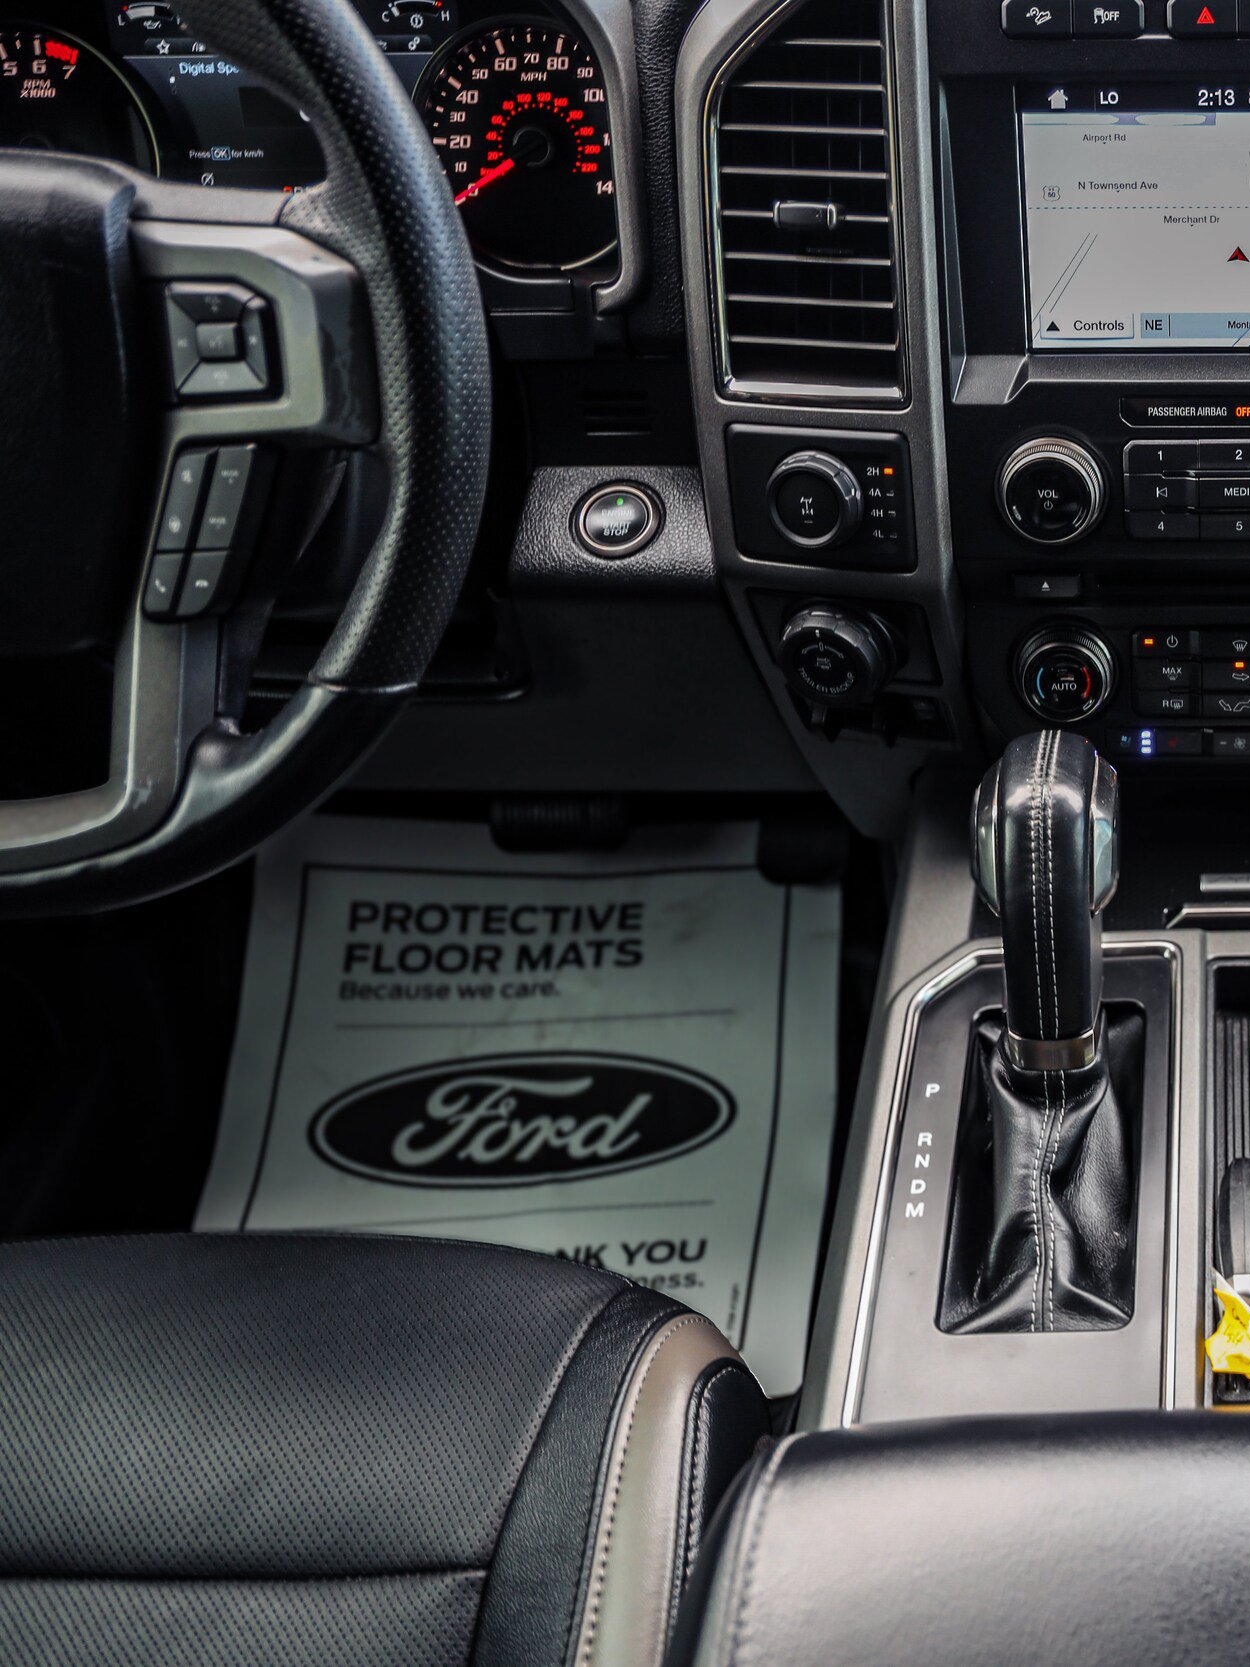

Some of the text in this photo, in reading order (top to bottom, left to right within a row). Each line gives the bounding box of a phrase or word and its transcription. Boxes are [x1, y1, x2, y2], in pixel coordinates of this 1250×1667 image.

[381, 11, 390, 22] C
[441, 10, 450, 22] H
[1104, 11, 1120, 21] OFF
[494, 57, 518, 72] 60
[523, 53, 540, 65] 70
[546, 56, 570, 71] 80
[3, 61, 18, 77] 5
[32, 59, 47, 75] 6
[62, 64, 77, 80] 7
[179, 61, 214, 76] Digital
[577, 67, 594, 79] 90
[472, 68, 489, 80] 50
[520, 72, 548, 82] MPH
[23, 79, 51, 90] RPM
[456, 90, 479, 104] 40
[536, 91, 552, 103] 120
[1100, 91, 1119, 105] LO
[1198, 89, 1235, 106] 2:13
[449, 111, 466, 123] 30
[449, 134, 471, 149] 20
[485, 131, 498, 141] 40
[1082, 133, 1126, 143] Airport Rd
[189, 149, 211, 159] Press
[584, 144, 601, 155] 200
[487, 151, 499, 161] 20
[455, 161, 467, 173] 10
[581, 162, 598, 173] 220
[1078, 181, 1158, 190] N Townsend Ave
[1163, 215, 1220, 224] Merchant Dr
[1073, 319, 1125, 331] Controls
[1145, 320, 1163, 331] NE
[1148, 406, 1228, 417] PASSENGER AIRBAG
[1157, 450, 1164, 461] 1
[1235, 449, 1243, 460] 2
[866, 466, 880, 476] 2H
[868, 488, 881, 498] 4A
[1037, 489, 1059, 499] VOL
[1157, 520, 1165, 531] 4
[1235, 521, 1243, 531] 5
[603, 528, 629, 537] STOP
[1162, 667, 1182, 675] MAX
[1051, 682, 1077, 692] AUTO
[1162, 700, 1169, 708] R
[347, 900, 645, 936] PROTECTIVE
[342, 938, 644, 975] FLOOR MATS
[339, 979, 561, 1000] Because we care.
[925, 1083, 941, 1098] P
[391, 1074, 653, 1168] Ford
[917, 1131, 933, 1147] R
[914, 1153, 930, 1169] N
[910, 1179, 927, 1195] D
[905, 1201, 925, 1218] M
[620, 1238, 708, 1267] YOU
